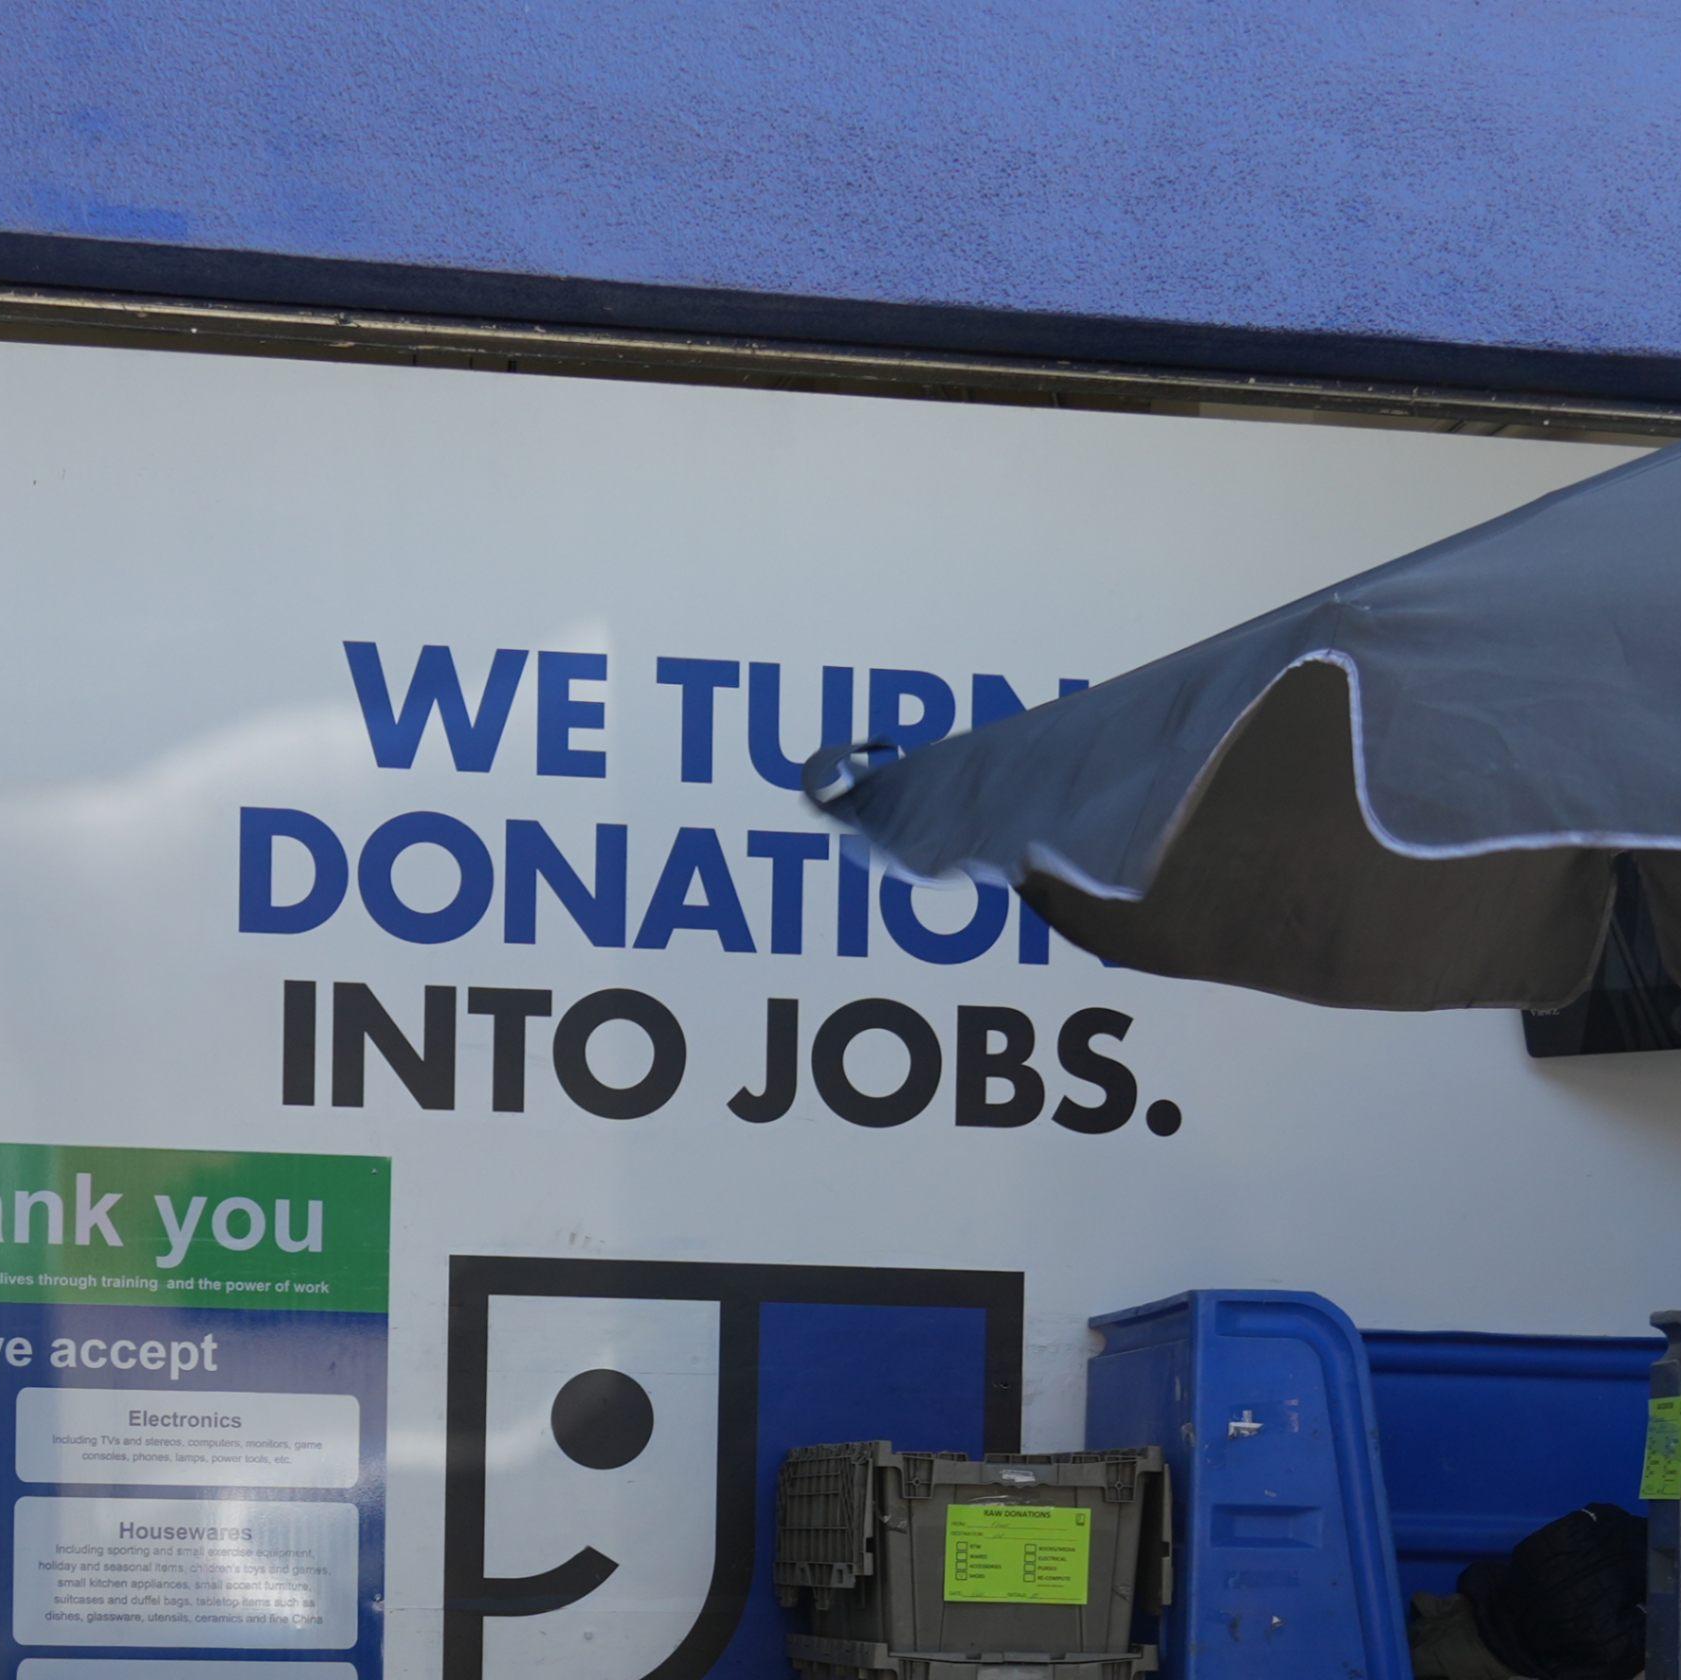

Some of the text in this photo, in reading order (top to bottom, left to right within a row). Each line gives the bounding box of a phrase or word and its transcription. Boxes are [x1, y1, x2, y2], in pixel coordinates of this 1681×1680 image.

[342, 640, 608, 779] WE
[238, 805, 1122, 968] DONATIO
[281, 979, 1183, 1138] INTO JOBS.
[153, 1195, 324, 1269] you
[0, 1272, 34, 1286] lives
[39, 1273, 97, 1289] through
[101, 1275, 159, 1291] training
[166, 1277, 194, 1290] and
[198, 1277, 221, 1291] the
[226, 1280, 271, 1295] power
[275, 1279, 290, 1292] of
[294, 1280, 330, 1294] work
[48, 1331, 219, 1380] accept
[127, 1409, 242, 1428] Electronics
[52, 1434, 97, 1447] Including
[100, 1435, 120, 1446] TVs
[123, 1436, 142, 1447] and
[294, 1441, 323, 1451] game
[119, 1521, 252, 1542] Housewares
[984, 1509, 1051, 1519] RAW DONATIONS
